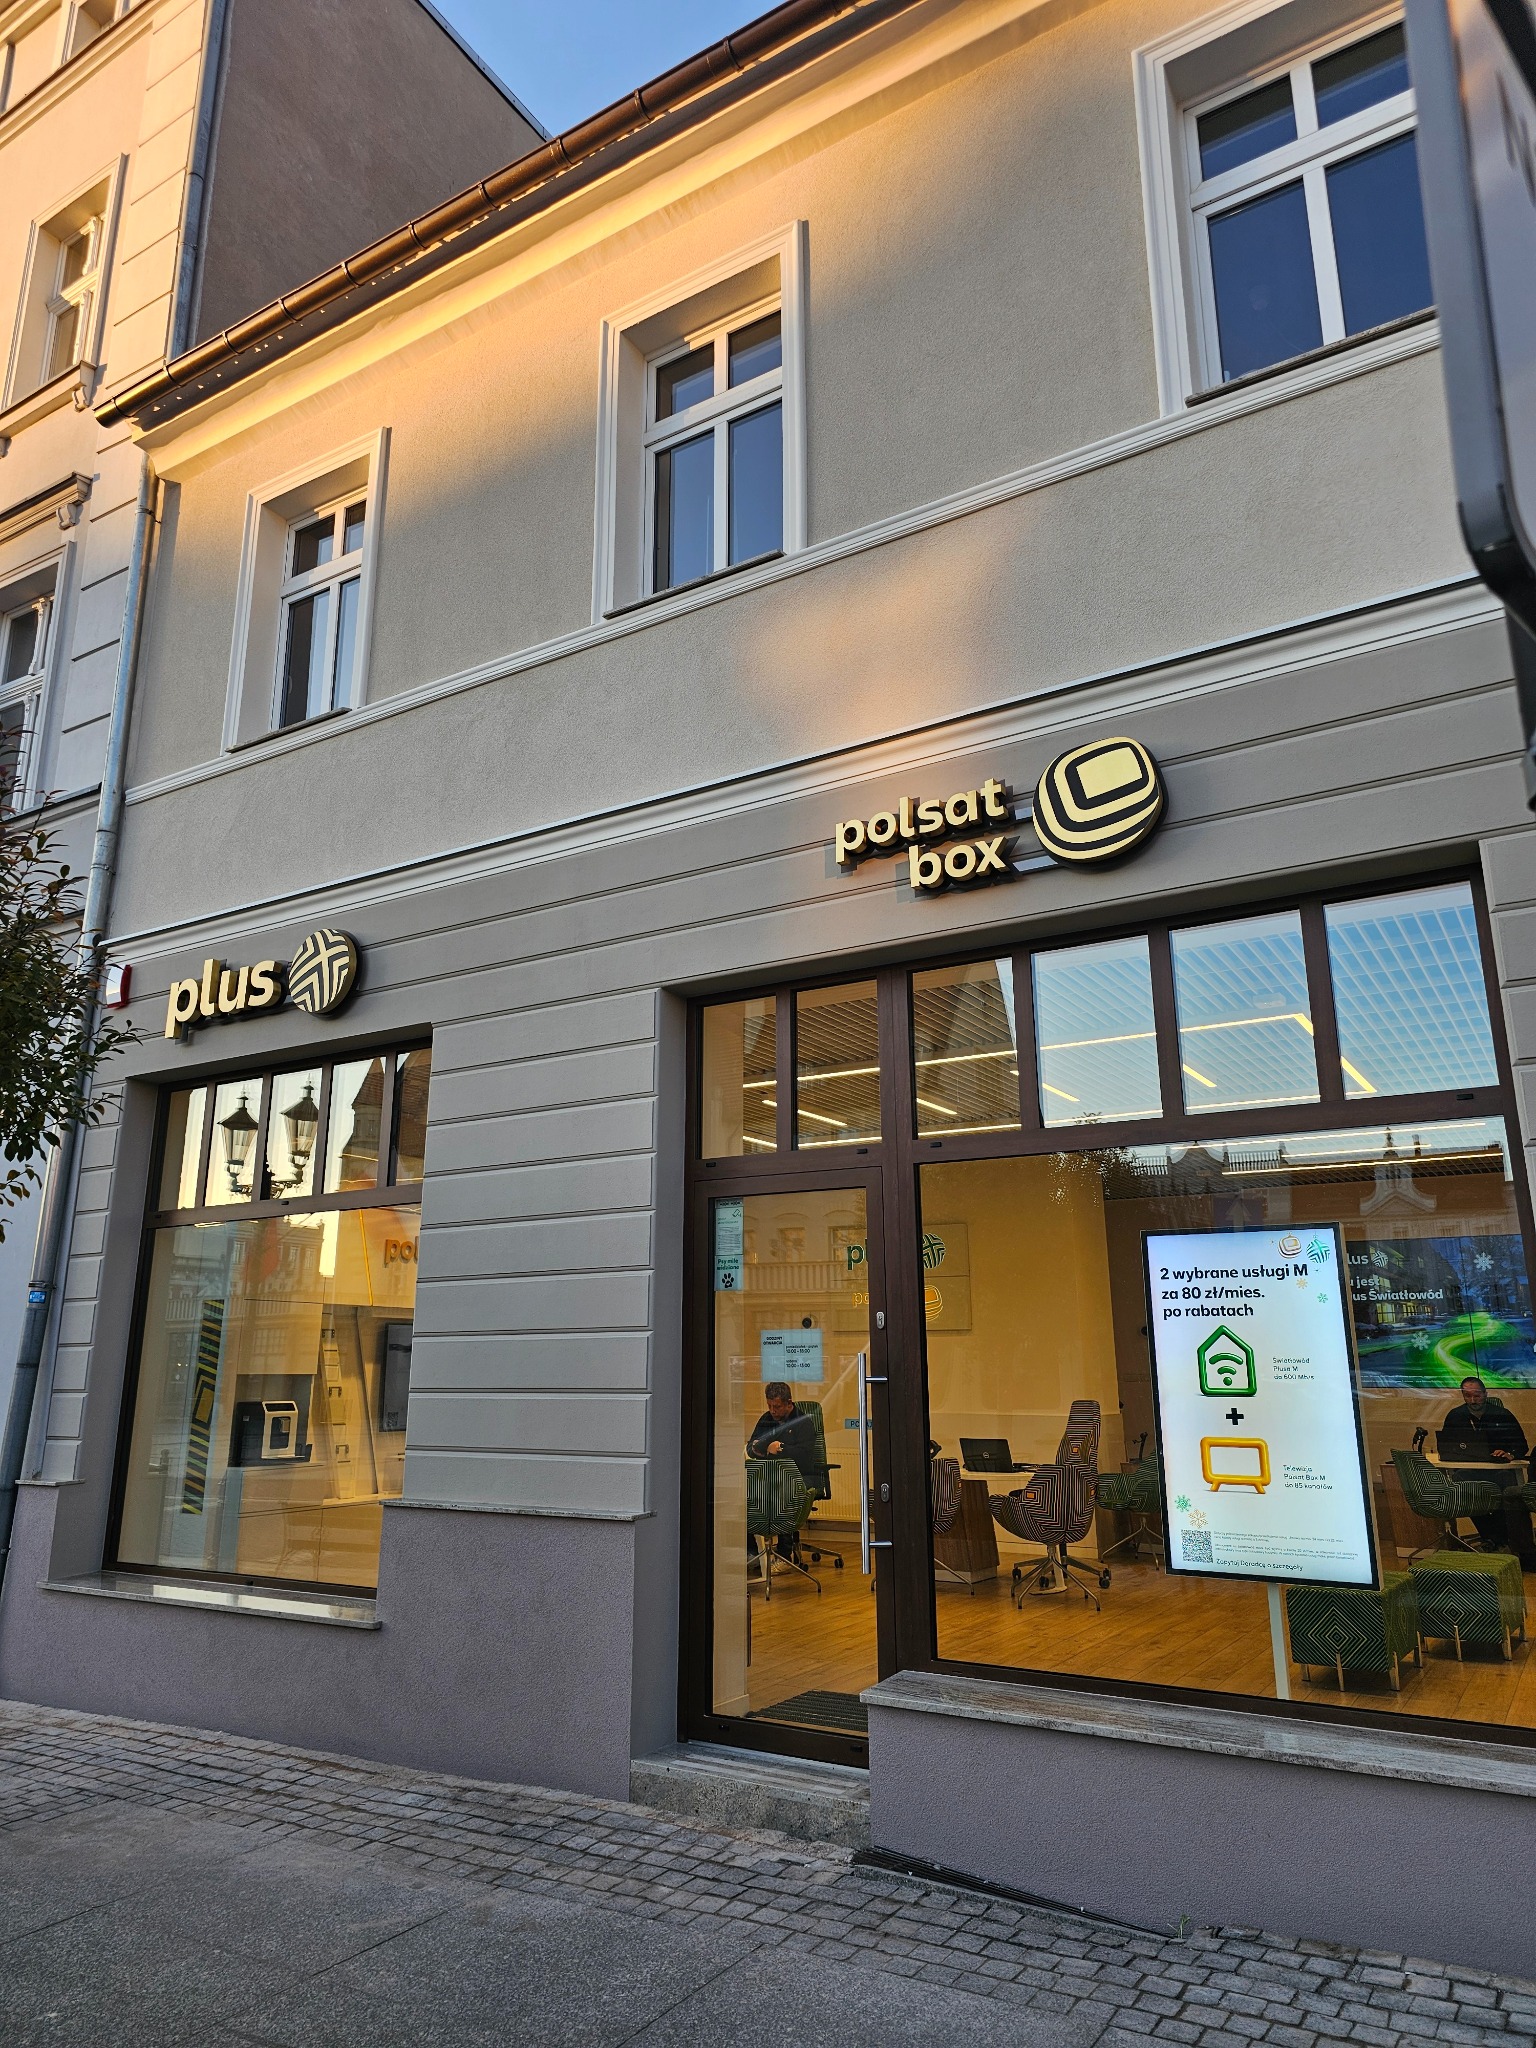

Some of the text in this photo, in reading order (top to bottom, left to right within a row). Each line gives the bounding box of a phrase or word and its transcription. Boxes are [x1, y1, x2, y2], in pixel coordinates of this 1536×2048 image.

[835, 778, 1008, 865] polsat
[908, 836, 1008, 889] box
[165, 958, 279, 1040] plus
[1160, 1263, 1309, 1282] 2 wybrane usługi M
[1356, 1276, 1380, 1289] jest
[1161, 1285, 1265, 1300] za 80 zł/mies.
[1368, 1288, 1444, 1301] Światłowód
[1163, 1303, 1254, 1320] po rabatach
